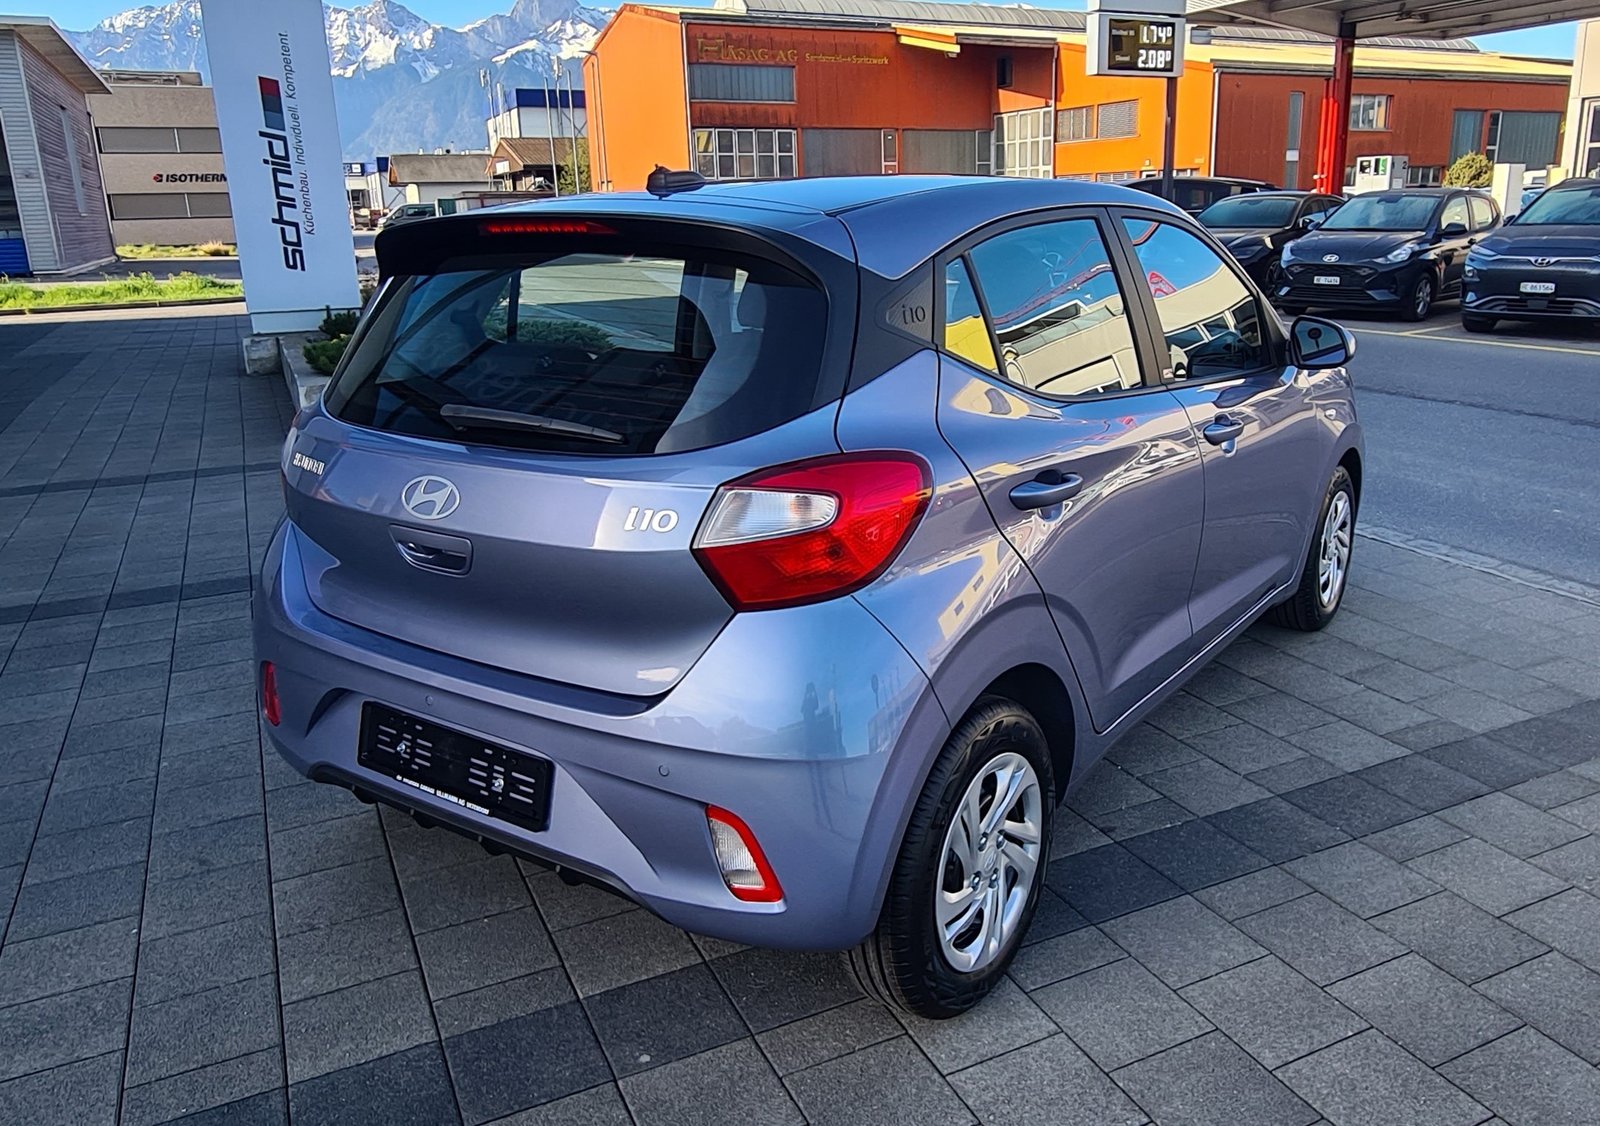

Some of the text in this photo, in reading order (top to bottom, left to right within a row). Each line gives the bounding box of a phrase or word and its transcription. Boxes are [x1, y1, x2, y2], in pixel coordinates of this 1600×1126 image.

[776, 49, 798, 62] AG
[278, 30, 315, 236] Küchenbau. Individuell. Kompetent.
[1402, 161, 1408, 170] 2
[258, 130, 306, 271] schmid
[902, 304, 926, 325] i10
